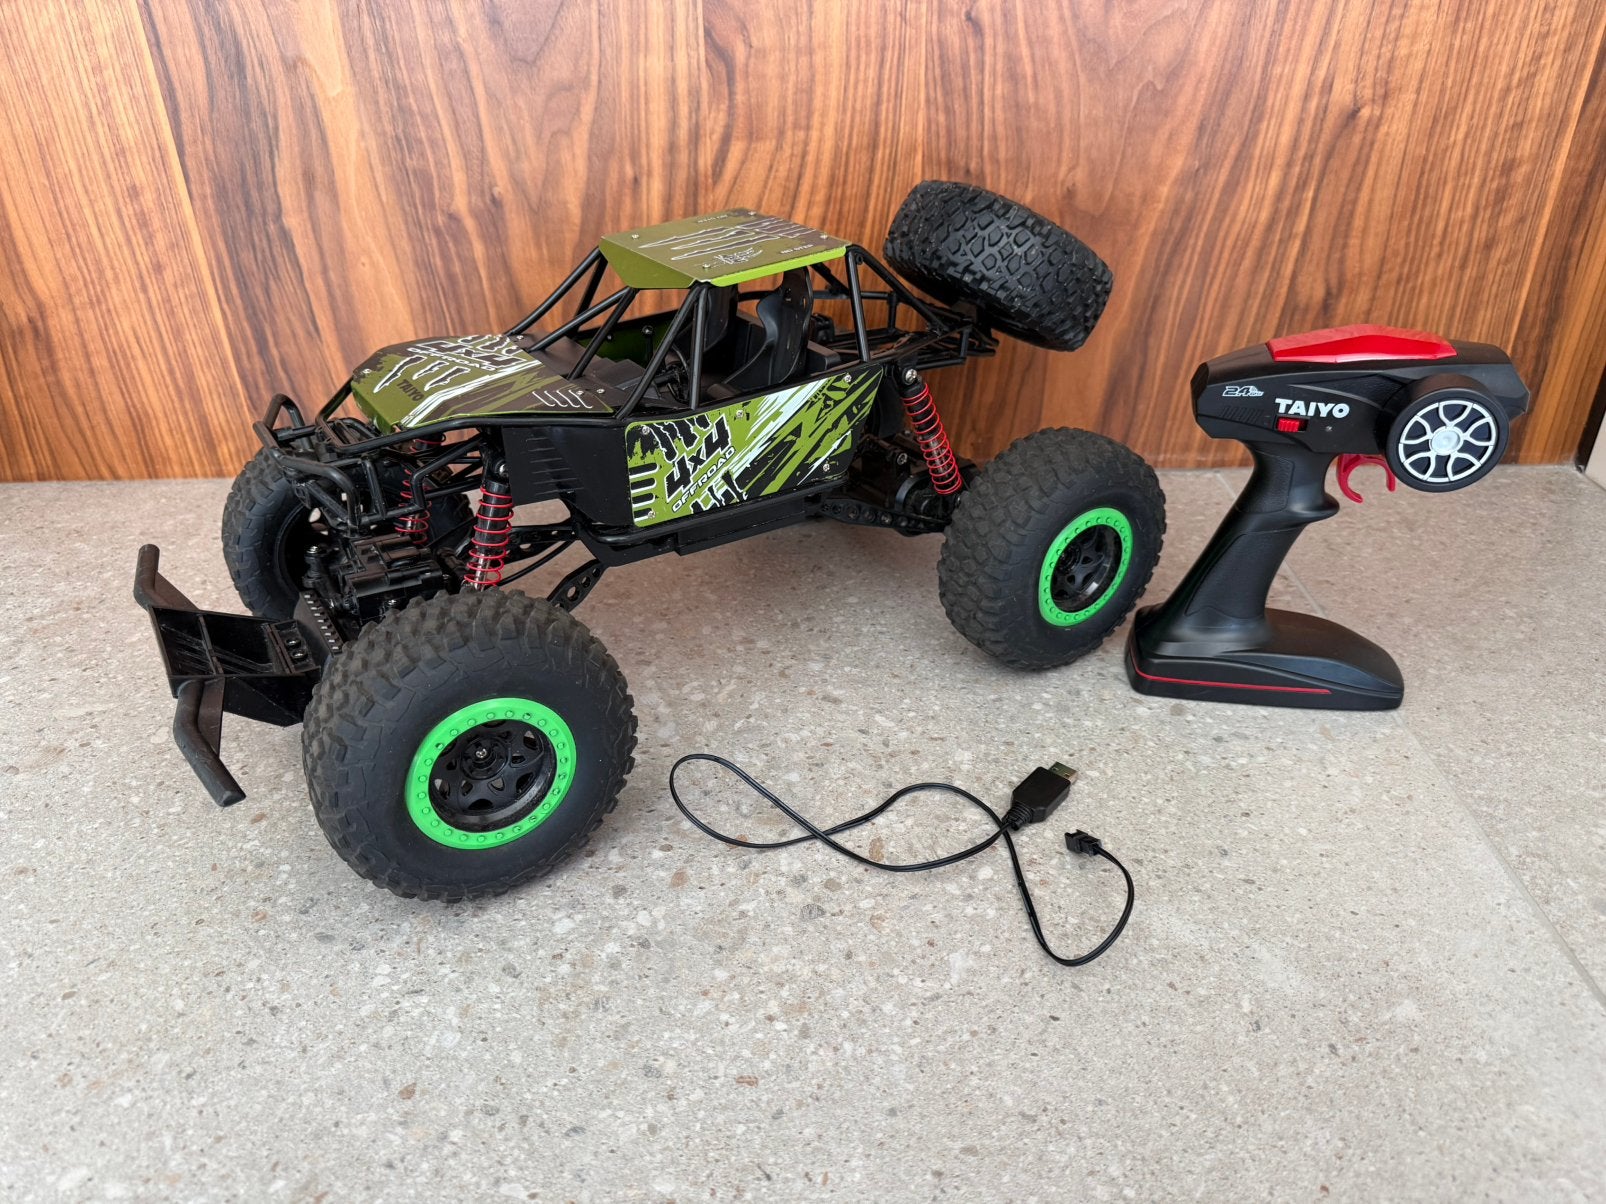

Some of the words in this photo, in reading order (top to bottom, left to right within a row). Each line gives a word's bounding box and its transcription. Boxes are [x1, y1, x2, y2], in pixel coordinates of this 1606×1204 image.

[397, 379, 425, 402] TAIYO
[1275, 398, 1350, 418] TAIYO
[672, 446, 736, 512] OFFROAD
